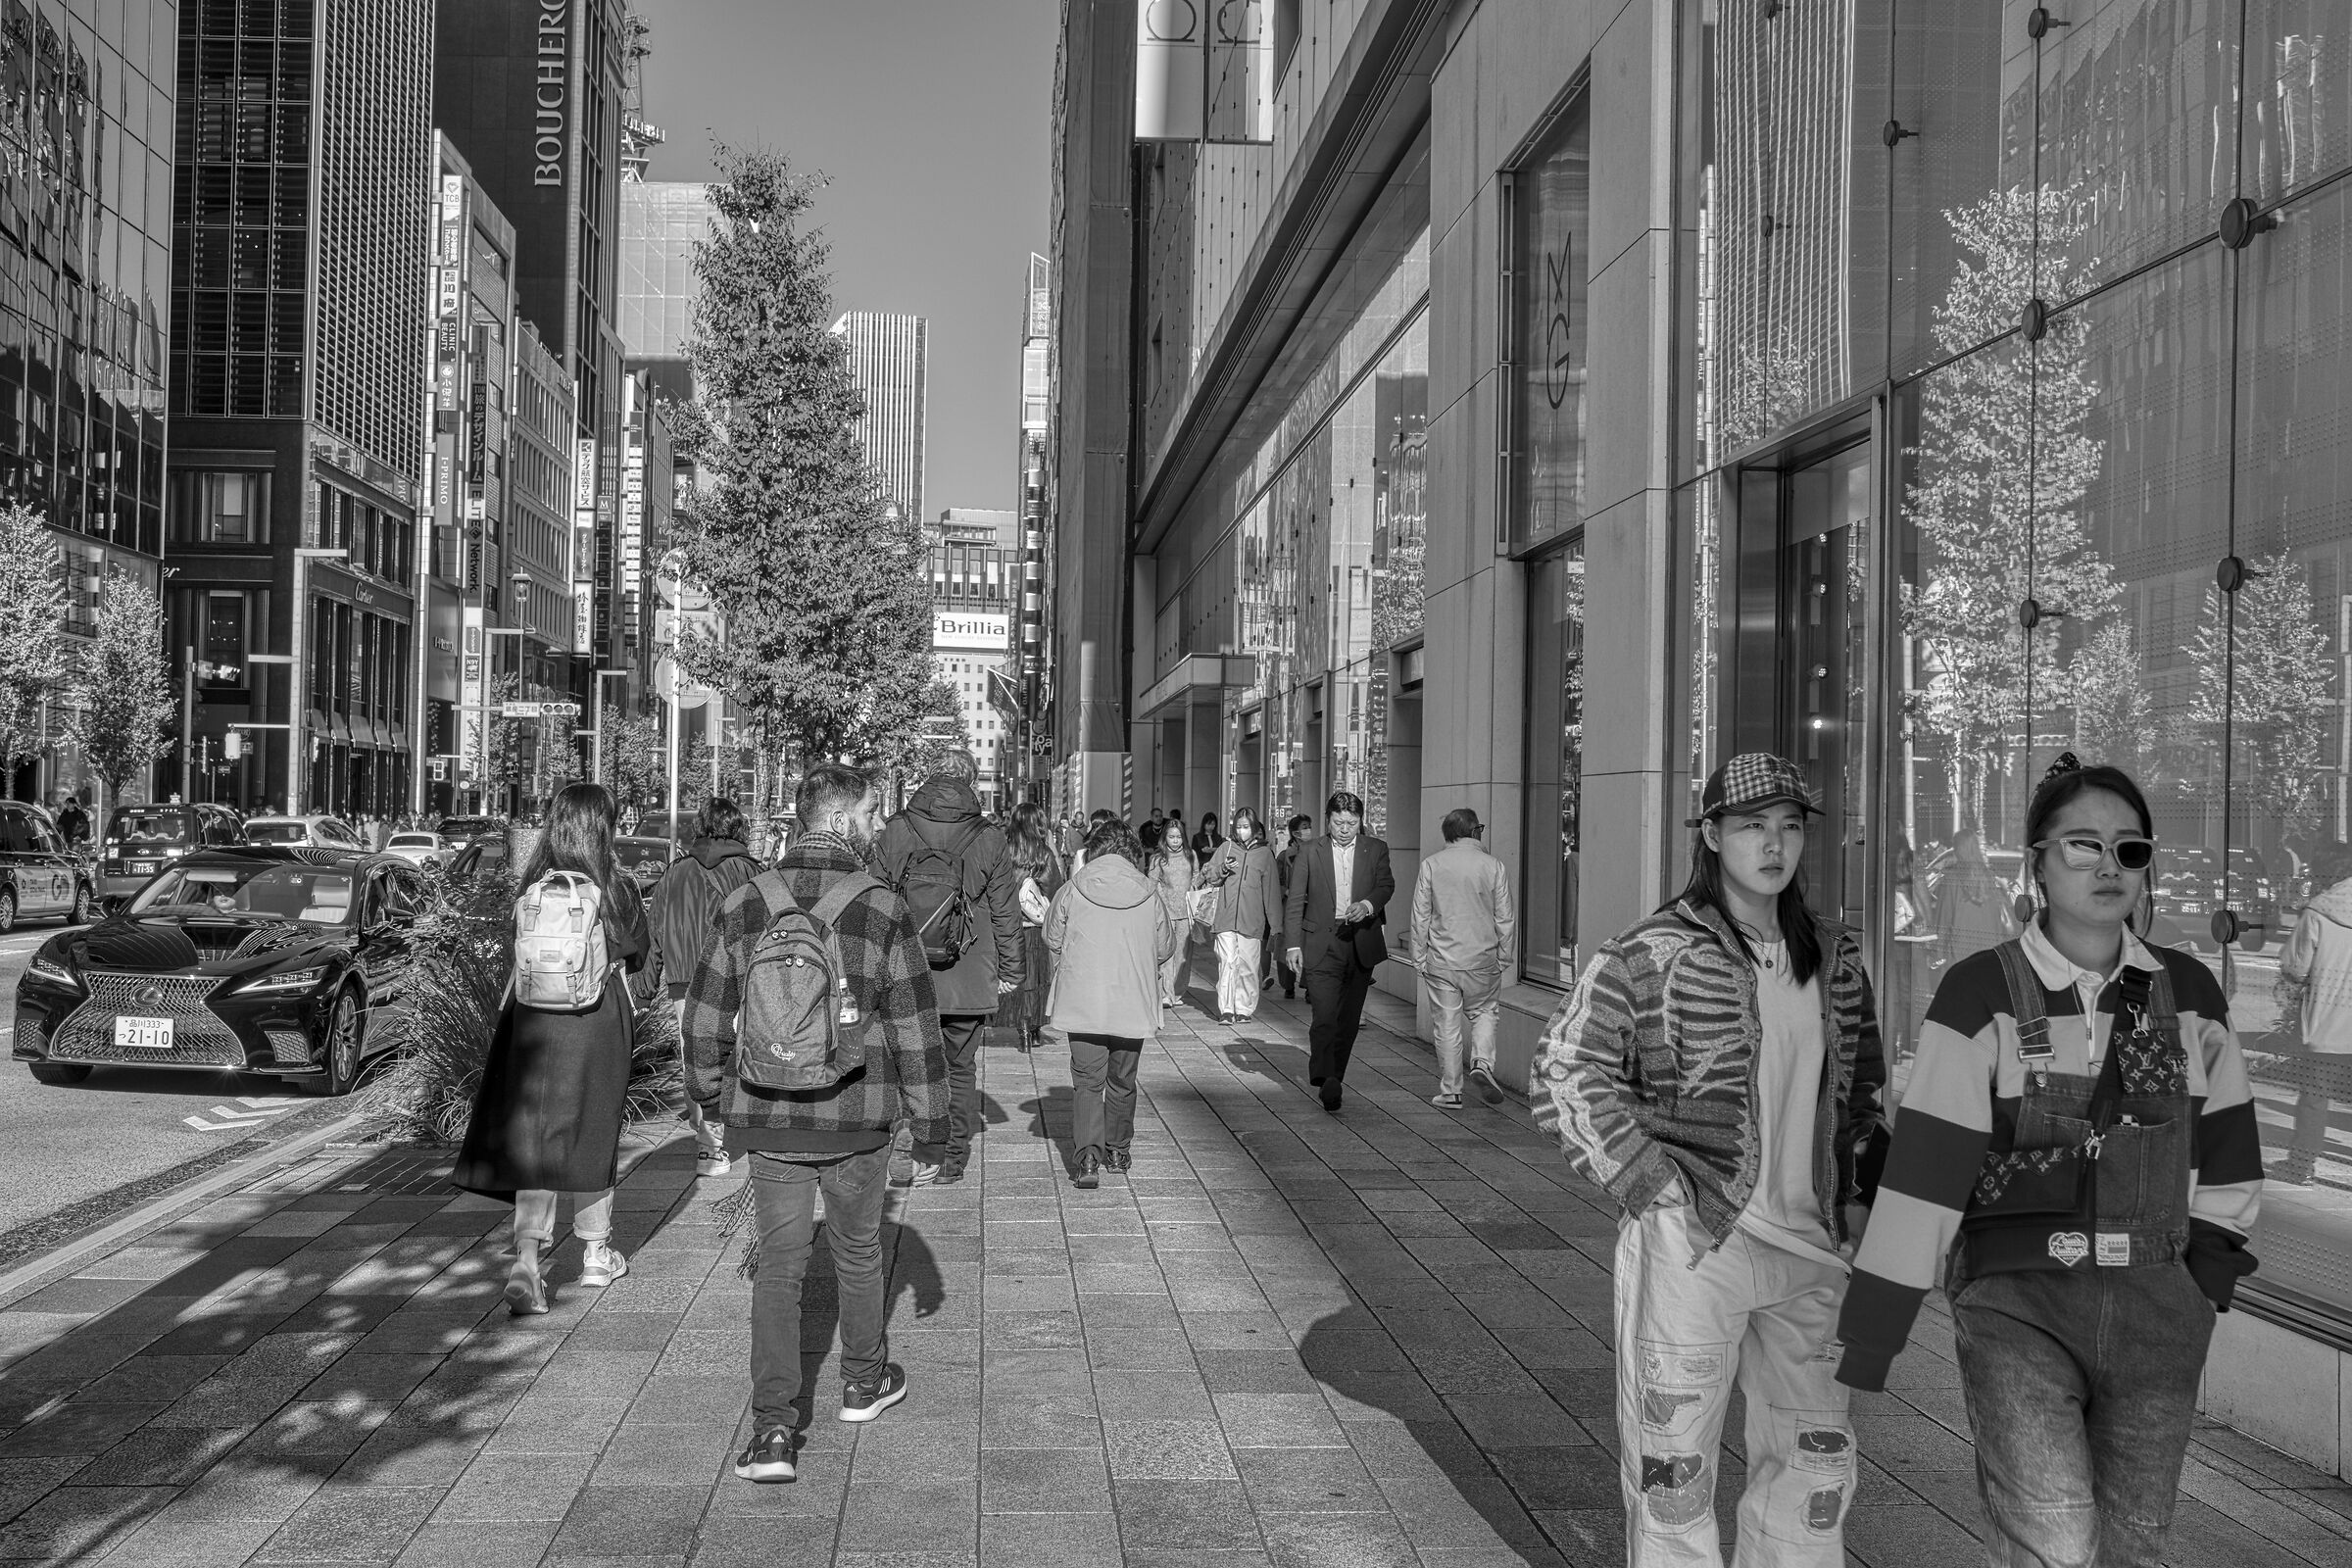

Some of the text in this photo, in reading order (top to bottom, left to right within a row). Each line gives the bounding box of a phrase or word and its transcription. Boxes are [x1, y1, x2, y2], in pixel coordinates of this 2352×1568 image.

[440, 322, 449, 351] BEAUTY
[441, 378, 453, 408] 小肥羊
[472, 394, 486, 482] 旅のデザインルーム
[440, 456, 449, 505] I-PRIMO
[580, 454, 592, 506] テック航空サービス
[470, 490, 482, 527] ELITE
[355, 580, 373, 605] Cartier
[941, 618, 1006, 636] Brillia
[127, 1029, 170, 1045] 21-10
